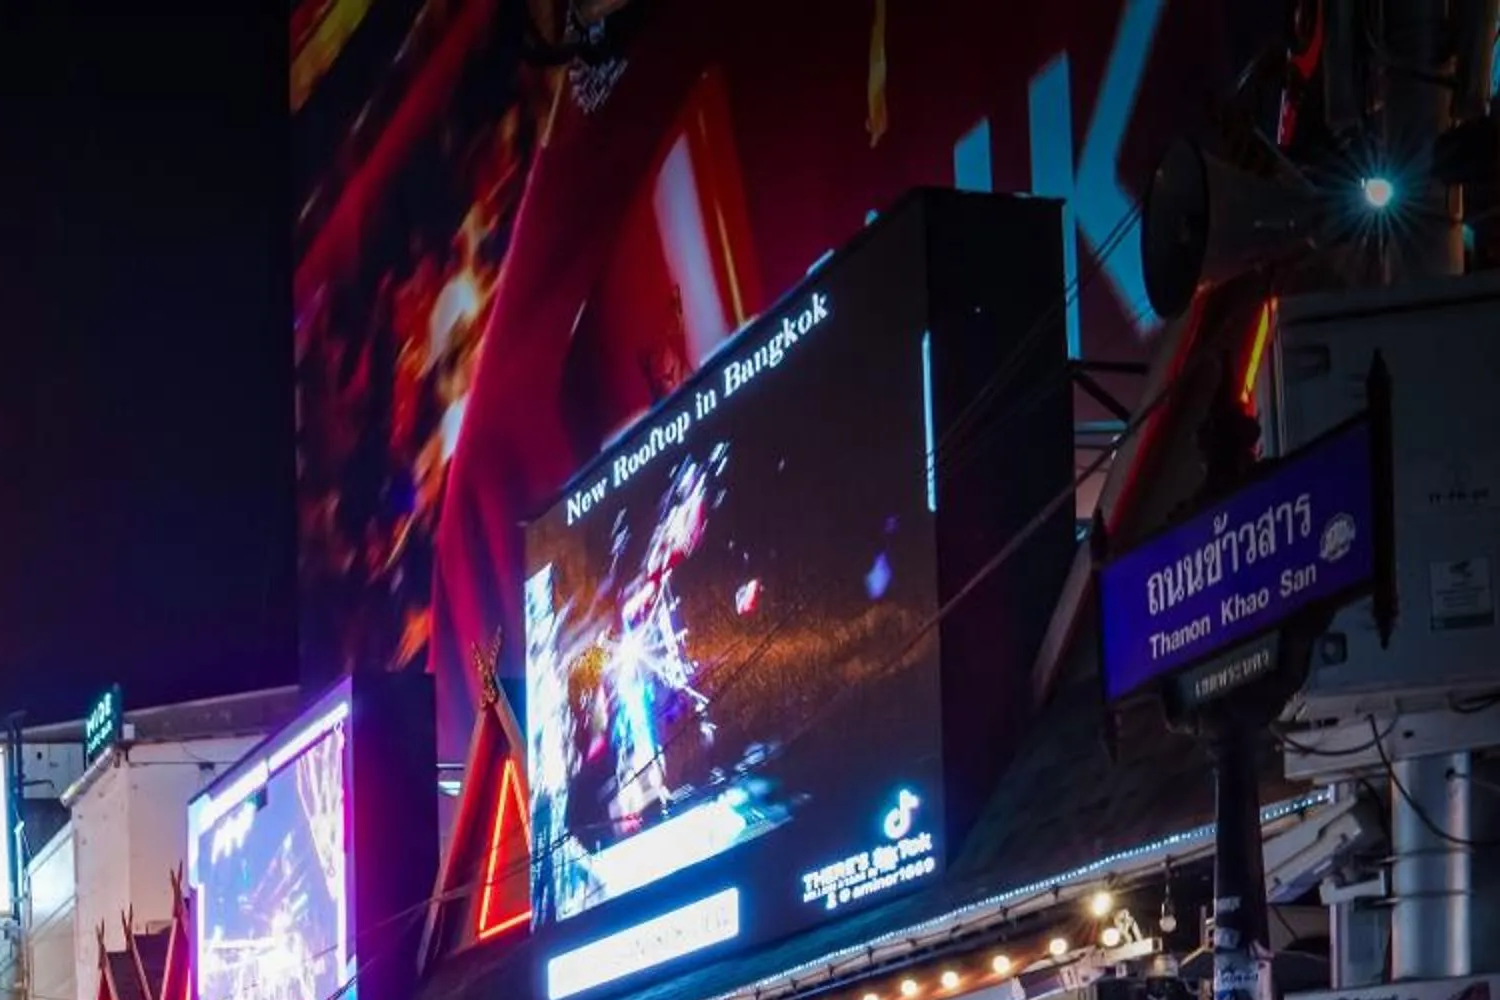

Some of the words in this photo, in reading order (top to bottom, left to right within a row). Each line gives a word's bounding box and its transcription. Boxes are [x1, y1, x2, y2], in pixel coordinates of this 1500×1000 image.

[564, 476, 608, 527] New
[612, 410, 691, 487] Rooftop
[695, 387, 717, 420] in
[724, 291, 830, 398] Bangkok
[1147, 493, 1311, 616] ถนนข้าวสาร
[1149, 616, 1211, 660] Thanon
[1221, 588, 1269, 625] Khao
[1280, 564, 1317, 597] San
